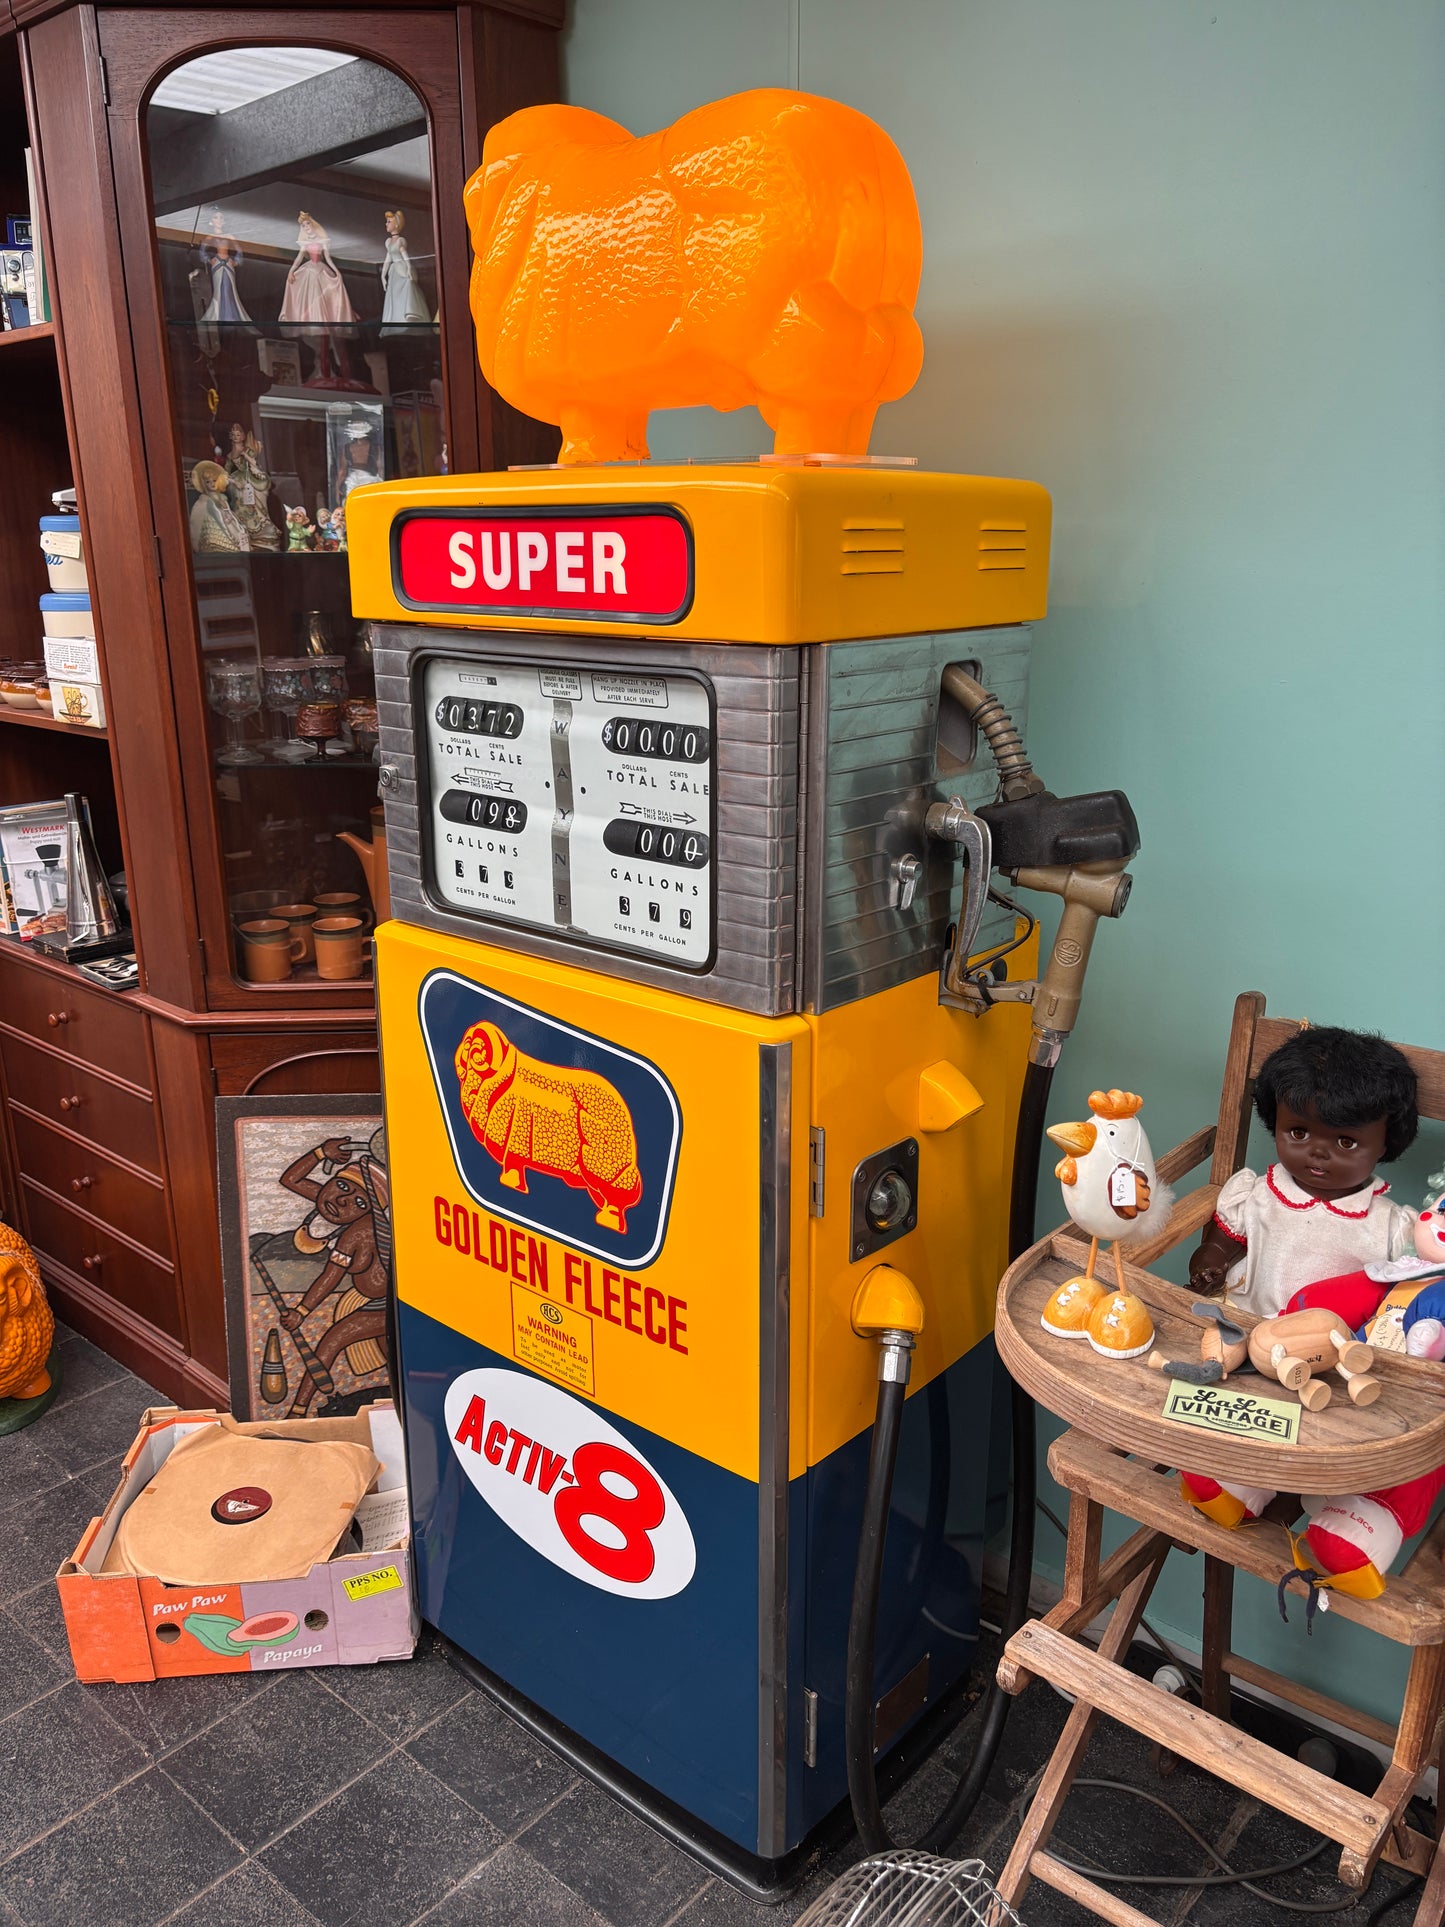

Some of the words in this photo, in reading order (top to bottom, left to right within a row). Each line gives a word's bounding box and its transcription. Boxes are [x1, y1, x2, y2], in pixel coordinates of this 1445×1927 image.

[448, 531, 628, 594] SUPER
[600, 685, 626, 693] PROVIDED
[438, 743, 480, 759] TOTAL
[490, 751, 523, 765] SALE
[450, 737, 471, 745] DOLLARS
[488, 742, 505, 751] CENTS
[606, 769, 657, 788] TOTAL
[669, 779, 709, 796] SALE
[621, 763, 647, 773] DOLLARS
[669, 770, 689, 779] CENTS
[643, 807, 656, 815] THIS
[657, 809, 672, 818] DIAL
[643, 812, 656, 820] THIS
[657, 816, 672, 824] HOSE
[21, 824, 65, 834] WESTMARK
[446, 833, 519, 858] GALLONS
[610, 867, 699, 897] GALLONS
[455, 886, 475, 896] CENTS
[478, 891, 490, 899] PER
[492, 895, 516, 906] GALLON
[613, 923, 636, 934] CENTS
[640, 929, 654, 938] PER
[658, 934, 687, 946] GALLON
[433, 1196, 549, 1293] GOLDEN
[564, 1252, 689, 1356] FLEECE
[527, 1315, 577, 1348] WARNING
[517, 1325, 532, 1336] MAY
[535, 1333, 566, 1354] CONTAIN
[568, 1349, 589, 1364] LEAD
[1180, 1400, 1283, 1432] VINTAGE
[1349, 1511, 1375, 1534] Lace
[349, 1576, 371, 1589] PPS
[371, 1570, 393, 1582] NO.
[152, 1600, 189, 1617] Paw
[191, 1593, 228, 1609] Paw
[263, 1644, 323, 1664] Papaya
